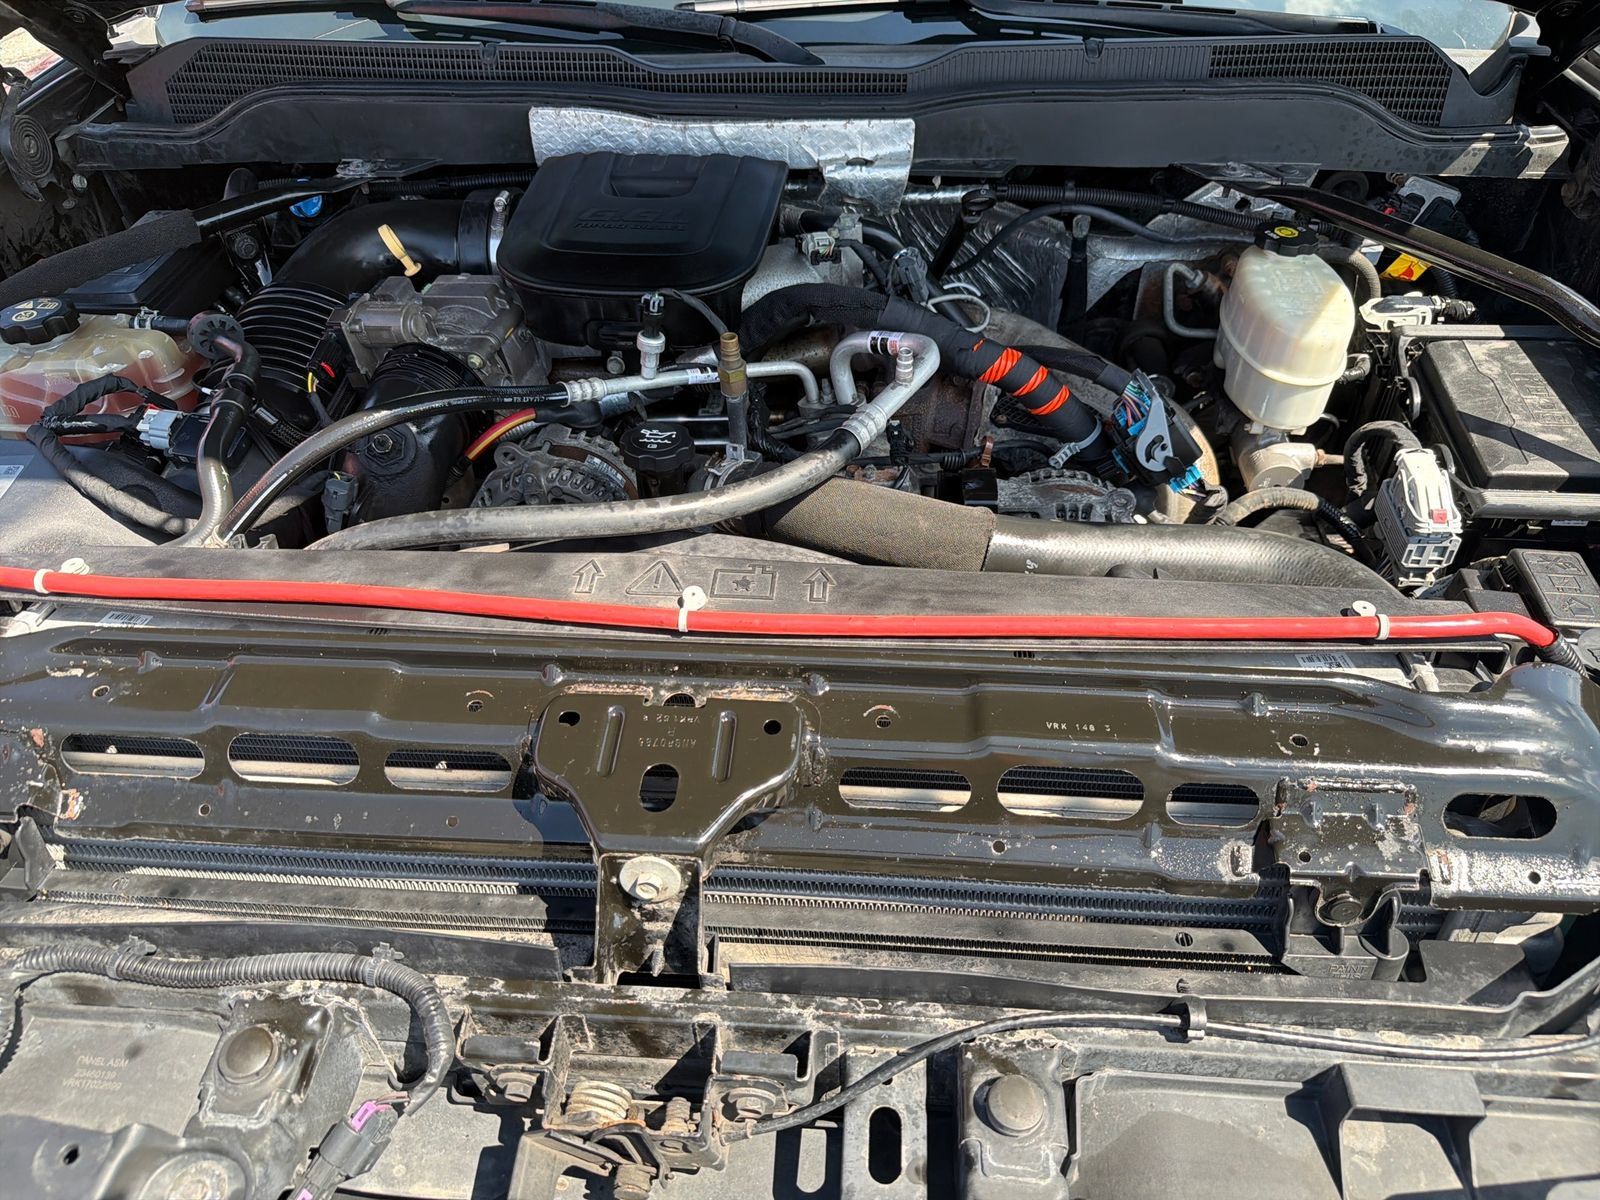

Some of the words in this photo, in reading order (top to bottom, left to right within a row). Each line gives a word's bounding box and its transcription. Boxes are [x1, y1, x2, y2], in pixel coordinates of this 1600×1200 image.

[1045, 721, 1067, 730] VRK
[77, 1055, 105, 1066] PANEL
[106, 1058, 129, 1068] ASM
